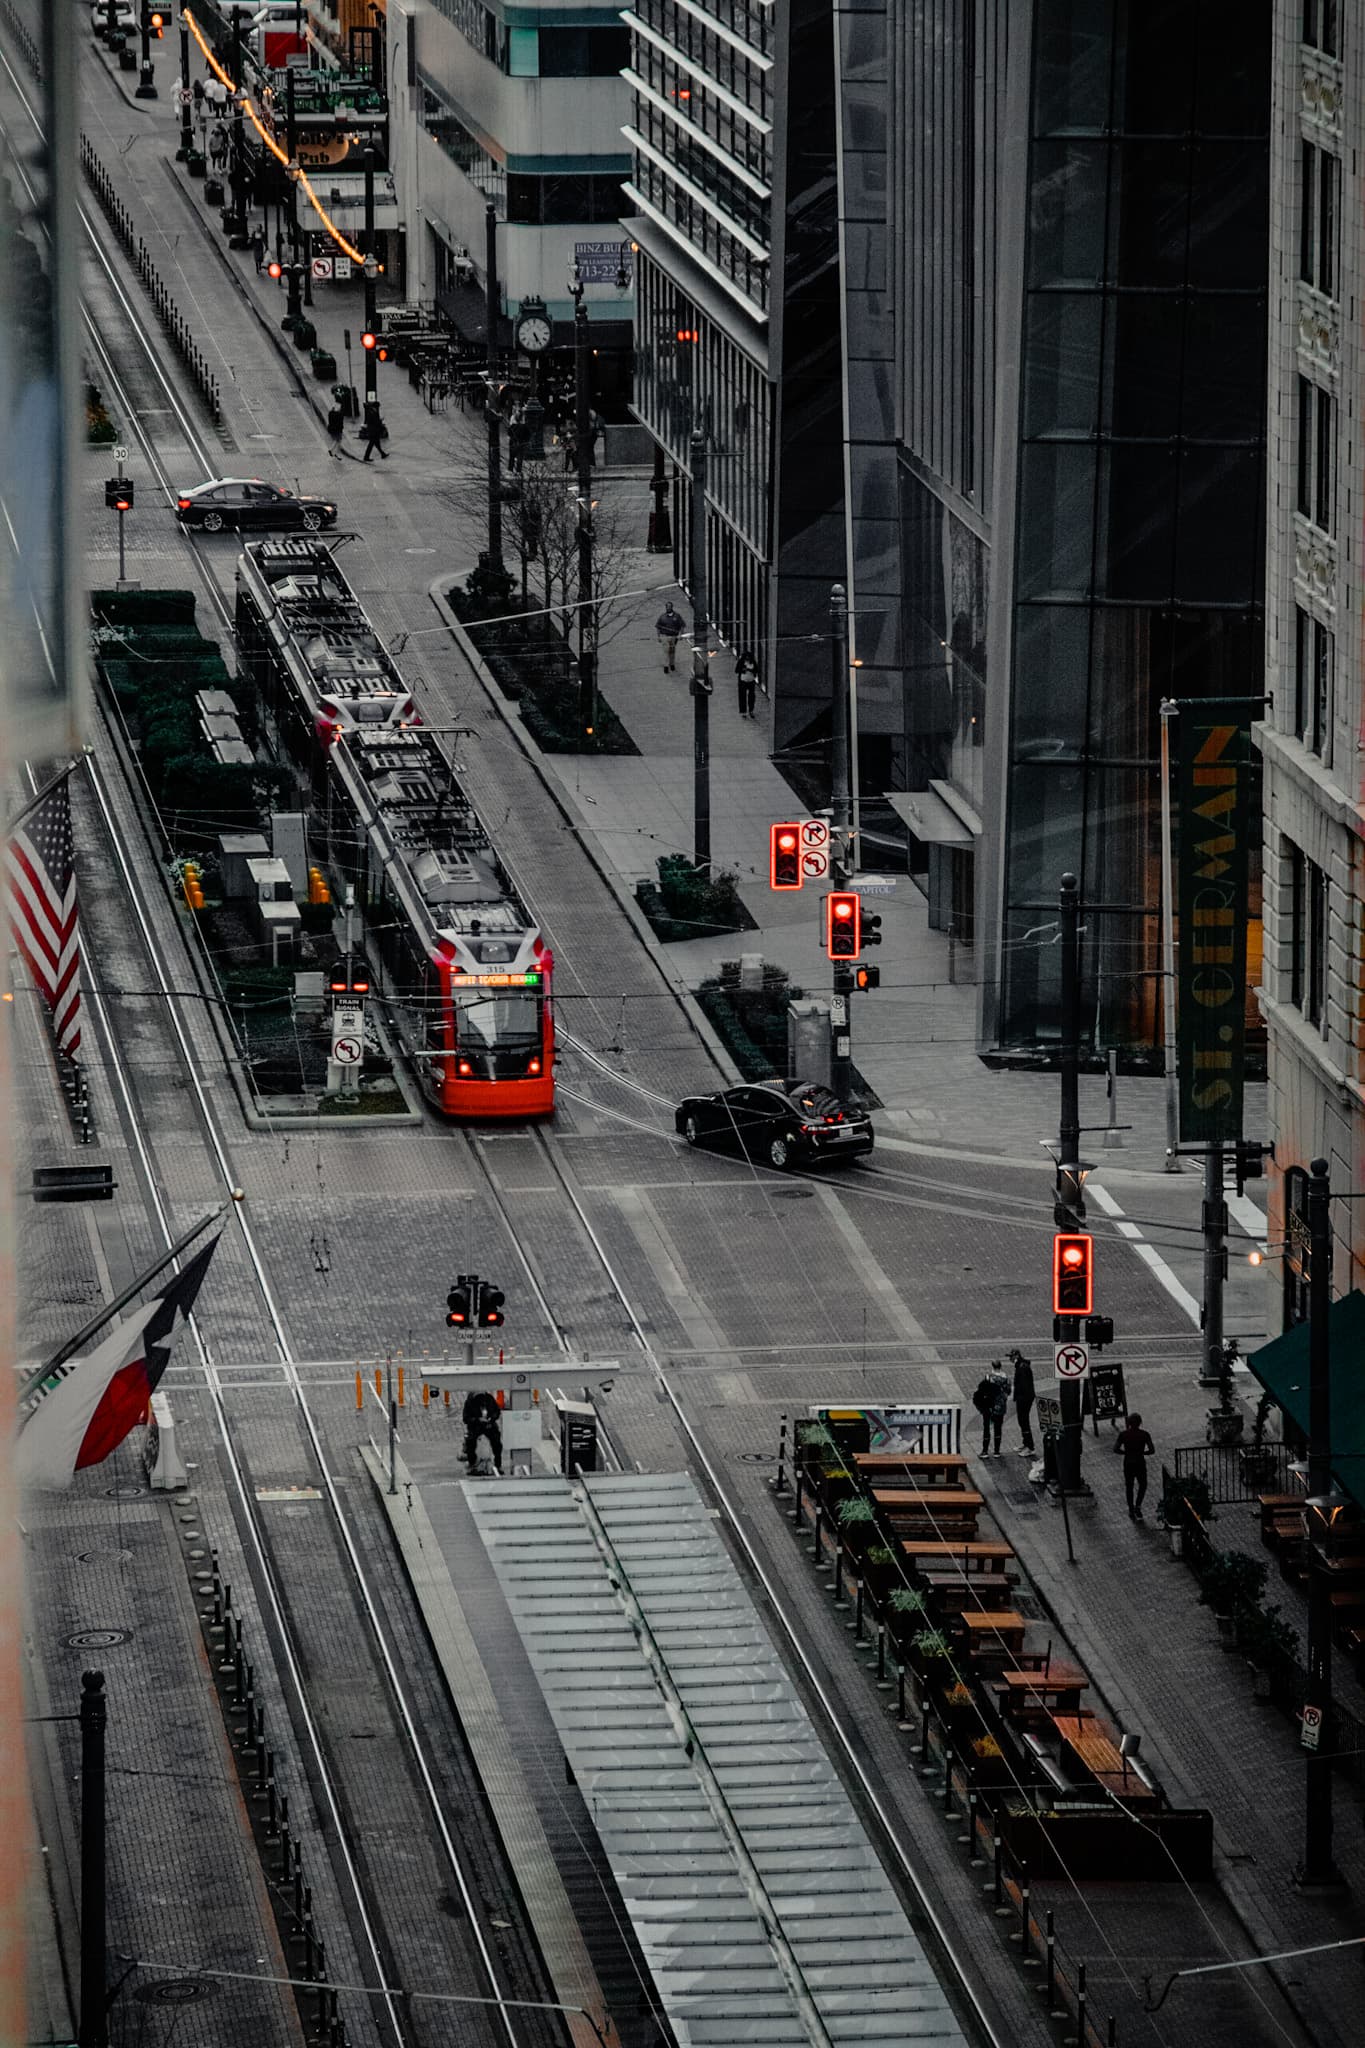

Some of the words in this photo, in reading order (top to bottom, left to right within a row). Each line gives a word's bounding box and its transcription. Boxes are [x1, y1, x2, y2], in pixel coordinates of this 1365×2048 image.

[298, 152, 330, 163] Pub
[115, 449, 126, 458] 30
[1191, 724, 1239, 1009] GERMAN
[893, 1414, 917, 1424] MAIN
[919, 1414, 949, 1423] STREET
